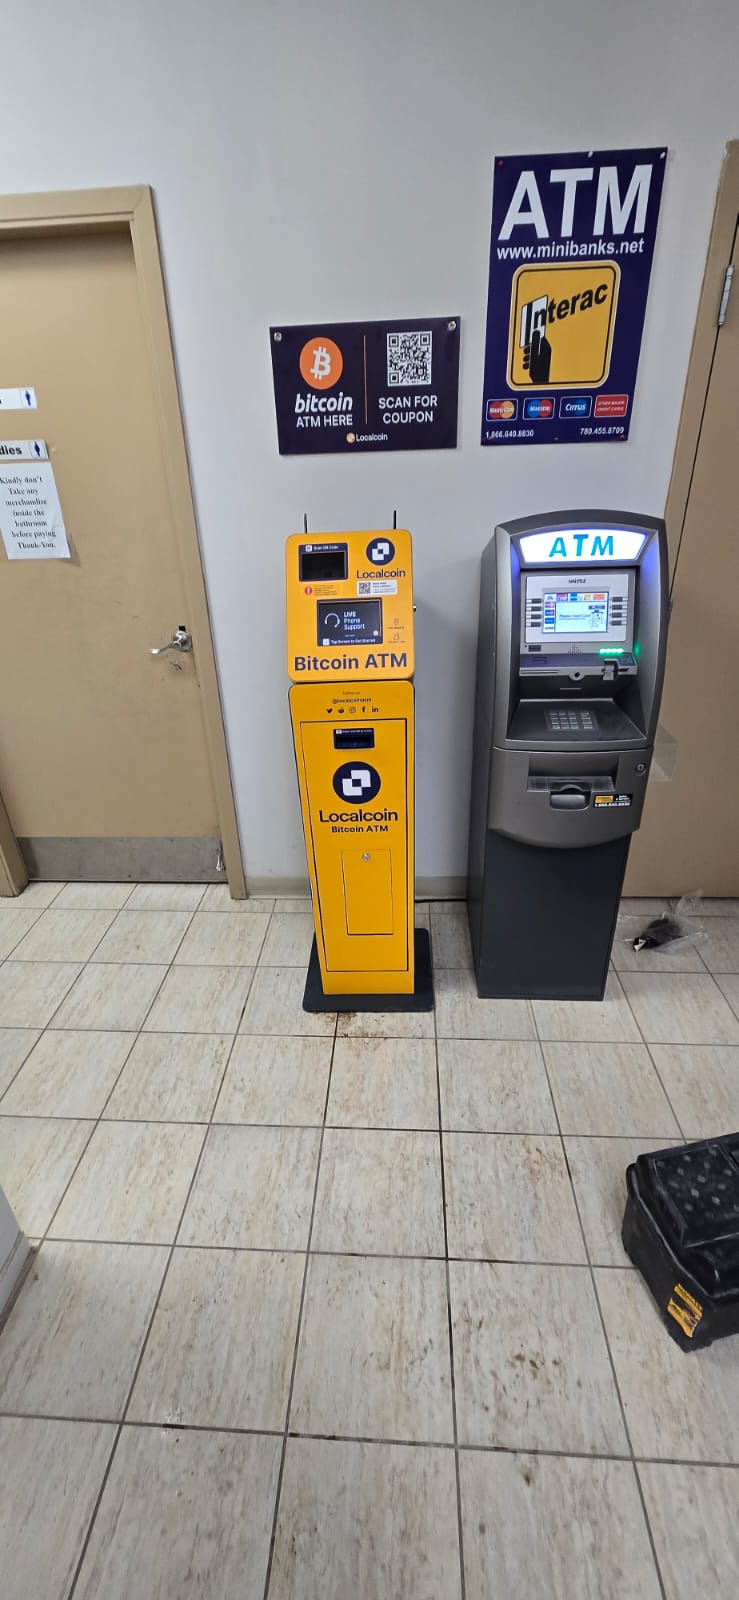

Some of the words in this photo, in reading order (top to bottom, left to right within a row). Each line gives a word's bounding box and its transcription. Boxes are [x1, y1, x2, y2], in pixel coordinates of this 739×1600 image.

[498, 164, 653, 240] ATM
[497, 238, 644, 259] www.minibanks.net
[524, 284, 608, 345] Interac
[294, 391, 353, 413] bitcoin
[378, 396, 411, 409] SCAN
[414, 395, 438, 408] FOR
[565, 403, 587, 411] Cirrus
[296, 415, 321, 428] ATM
[323, 414, 353, 427] HERE
[382, 410, 433, 424] COUPON
[356, 432, 388, 442] Localcoin
[548, 533, 614, 558] ATM
[356, 567, 406, 580] Localcoin
[294, 654, 359, 671] Bitcoin
[364, 652, 407, 669] ATM
[319, 808, 399, 823] Localcoin
[331, 825, 364, 833] Bitcoin
[366, 825, 389, 833] ATM
